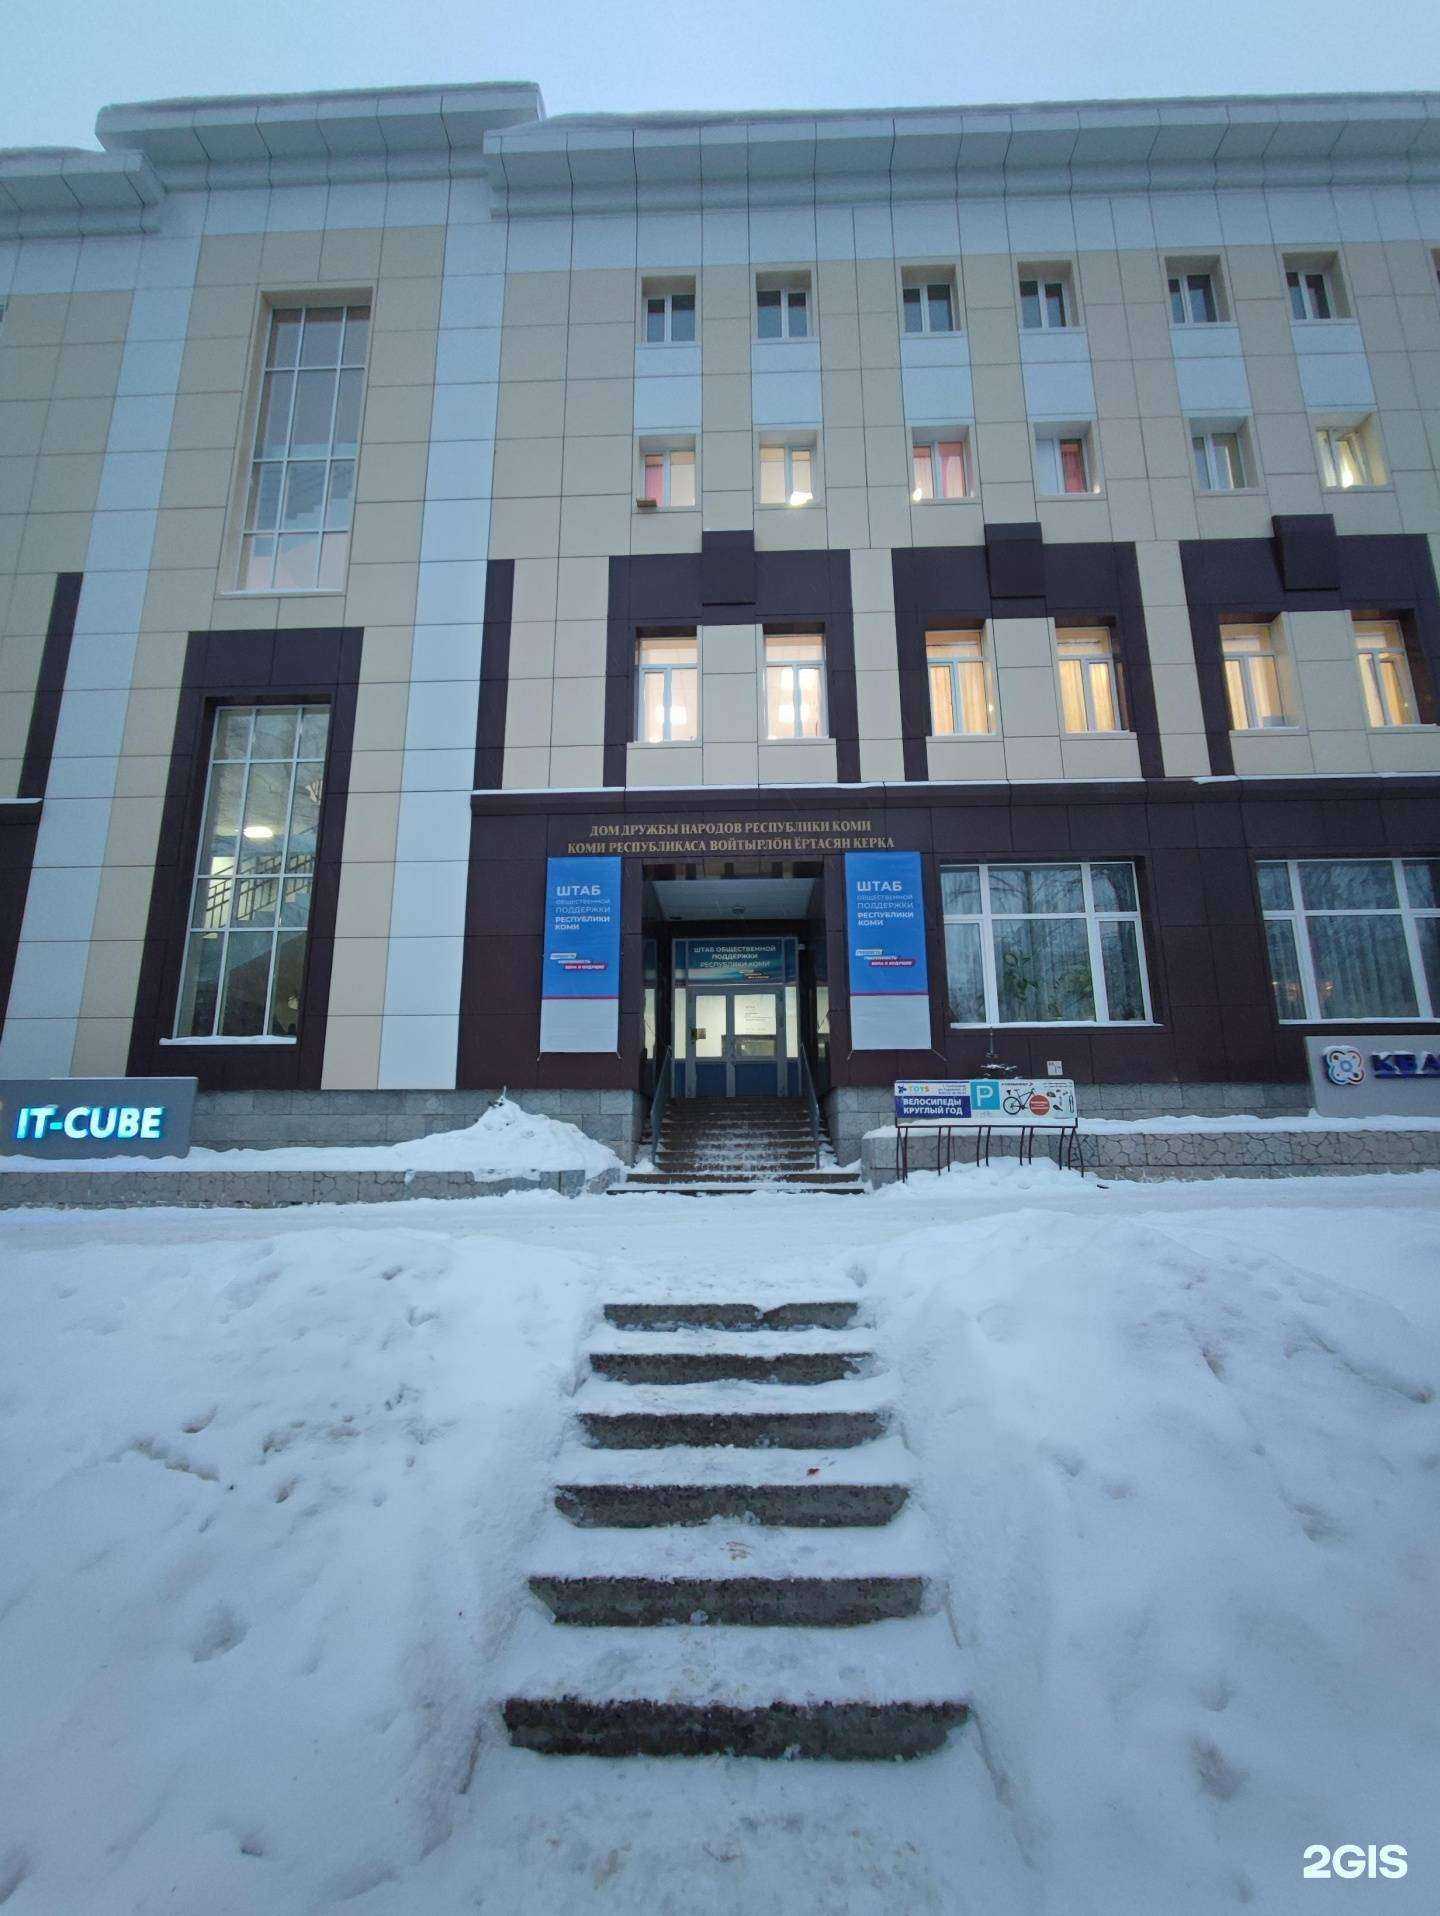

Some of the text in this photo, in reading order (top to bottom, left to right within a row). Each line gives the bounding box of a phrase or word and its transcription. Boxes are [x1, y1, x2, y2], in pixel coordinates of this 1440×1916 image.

[590, 820, 872, 837] ДОМ ДРУЖБЫ НАРОДОВ РЕСПУБЛИКИ КОМИ
[567, 842, 605, 854] КОМИ
[609, 839, 706, 853] РЕСПУБЛИКАСА
[556, 885, 601, 896] ШТАБ
[857, 881, 902, 892] ШТАБ
[857, 902, 914, 910] ПОДДЕРЖКИ
[857, 911, 914, 919] РЕСПУБЛИКИ
[716, 945, 776, 953] ОБЩЕСТВЕННОЙ
[976, 1085, 994, 1107] P
[903, 1098, 962, 1106] ВЕЛОСИПЕДЫ
[903, 1106, 963, 1115] КРУГЛЫЙ ГОД
[16, 1105, 164, 1139] IT-CUBE
